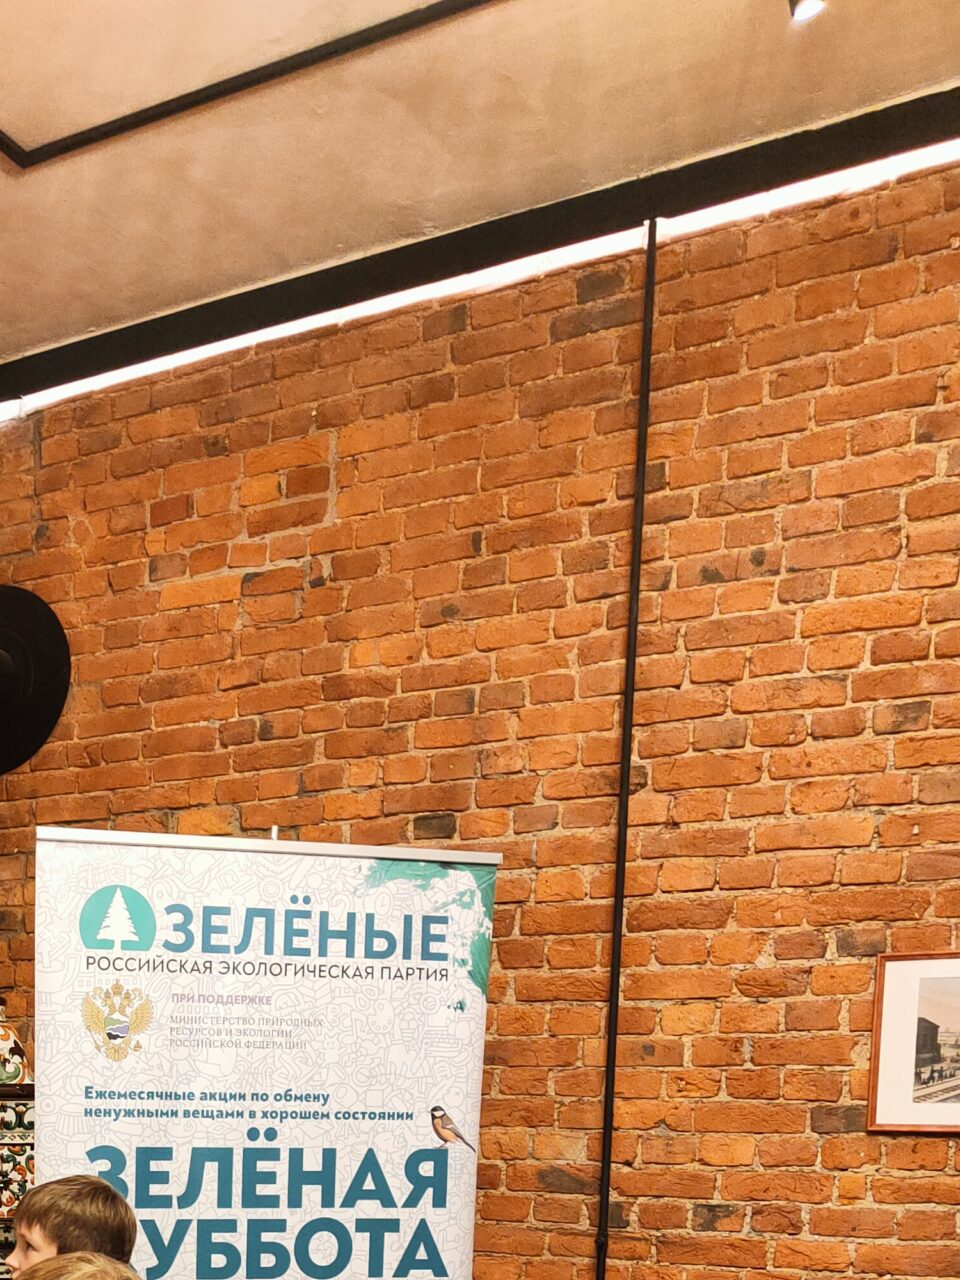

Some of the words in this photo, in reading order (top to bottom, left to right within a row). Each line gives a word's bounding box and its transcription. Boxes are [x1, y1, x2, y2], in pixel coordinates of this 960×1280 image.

[161, 894, 450, 961] ЗЕЛЁНЫЕ
[85, 955, 213, 976] РОССИЙСКАЯ
[218, 960, 375, 980] ЭКОЛОГИЧЕСКАЯ
[379, 965, 449, 982] ПАРТИЯ
[171, 993, 194, 1004] ПРИ
[198, 994, 272, 1006] ПОДДЕРЖКЕ
[170, 1015, 255, 1026] МИНИСТЕРСТВО
[258, 1017, 323, 1028] ПРИРОДНЫХ
[169, 1027, 222, 1037] РЕСУРСОВ
[225, 1028, 233, 1037] И
[236, 1028, 292, 1038] ЭКОЛОГИИ
[169, 1037, 241, 1049] РОССИЙСКОЙ
[244, 1040, 307, 1050] ФЕДЕРАЦИИ
[84, 1085, 195, 1102] Ежемесячные
[199, 1091, 246, 1104] акции
[250, 1091, 269, 1102] по
[273, 1088, 330, 1106] обмену
[83, 1107, 178, 1122] ненужными
[183, 1108, 244, 1122] вещами
[248, 1109, 257, 1120] в
[260, 1109, 330, 1124] хорошем
[334, 1110, 414, 1122] состоянии
[85, 1127, 449, 1209] ЗЕЛЁНАЯ
[128, 1216, 449, 1280] УББОТА
